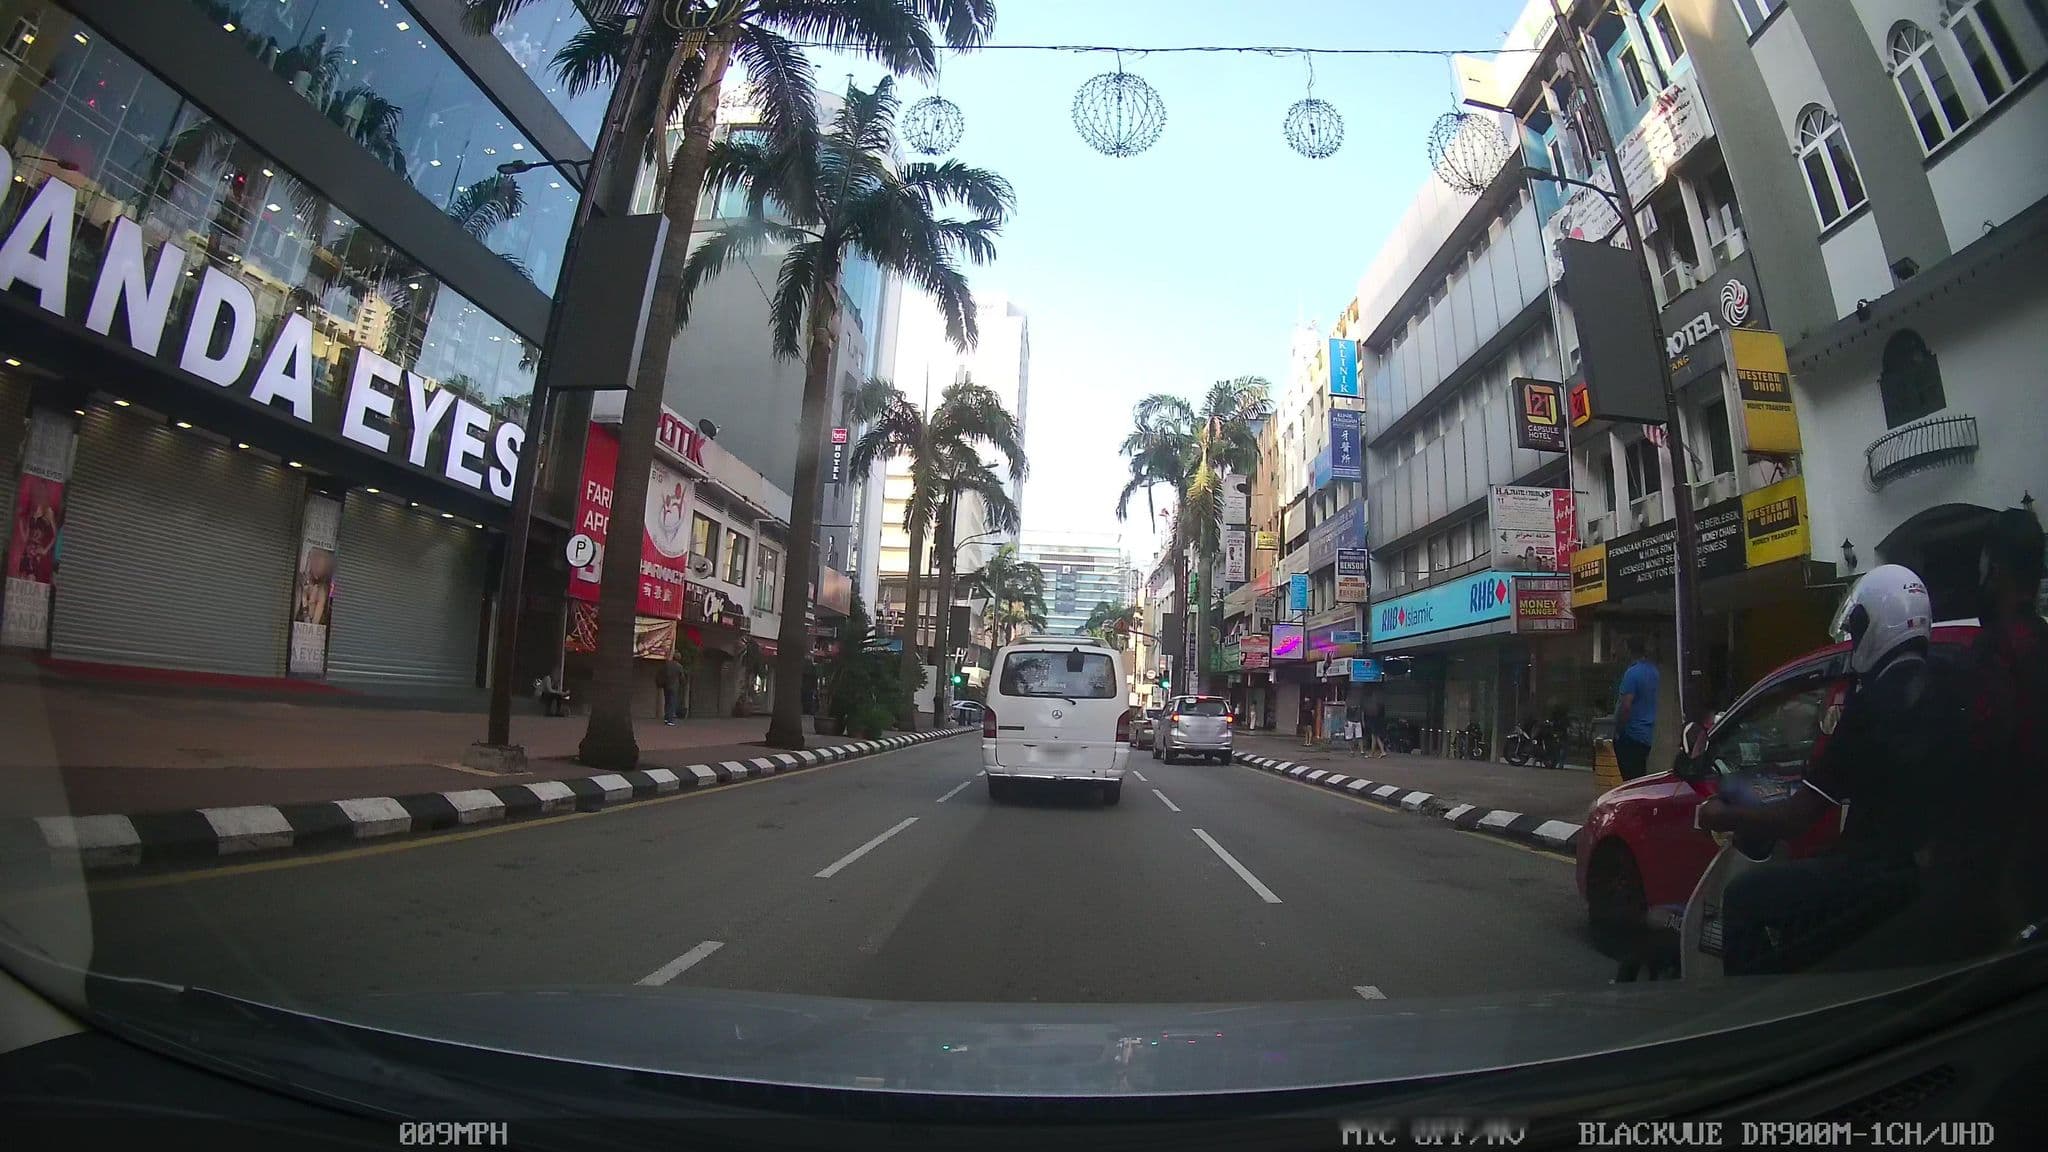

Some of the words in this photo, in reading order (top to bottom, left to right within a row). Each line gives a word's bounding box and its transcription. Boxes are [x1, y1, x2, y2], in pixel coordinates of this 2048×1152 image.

[1338, 340, 1349, 393] KLINIK
[1670, 355, 1690, 371] ANG
[1738, 371, 1780, 382] WESTERN
[1753, 381, 1782, 392] UNION
[341, 346, 527, 502] EYES
[1528, 425, 1559, 434] CAPSULE
[657, 410, 705, 468] OTIK
[1529, 432, 1551, 440] HOTEL
[832, 444, 842, 480] HOTEL
[1747, 500, 1789, 520] WESTERN
[1760, 510, 1790, 526] UNION
[575, 541, 586, 558] P
[1470, 578, 1495, 614] RHB
[1520, 600, 1557, 609] MONEY
[1520, 608, 1558, 616] CHANGER
[1382, 607, 1398, 632] RHB
[1404, 602, 1433, 629] Islamic
